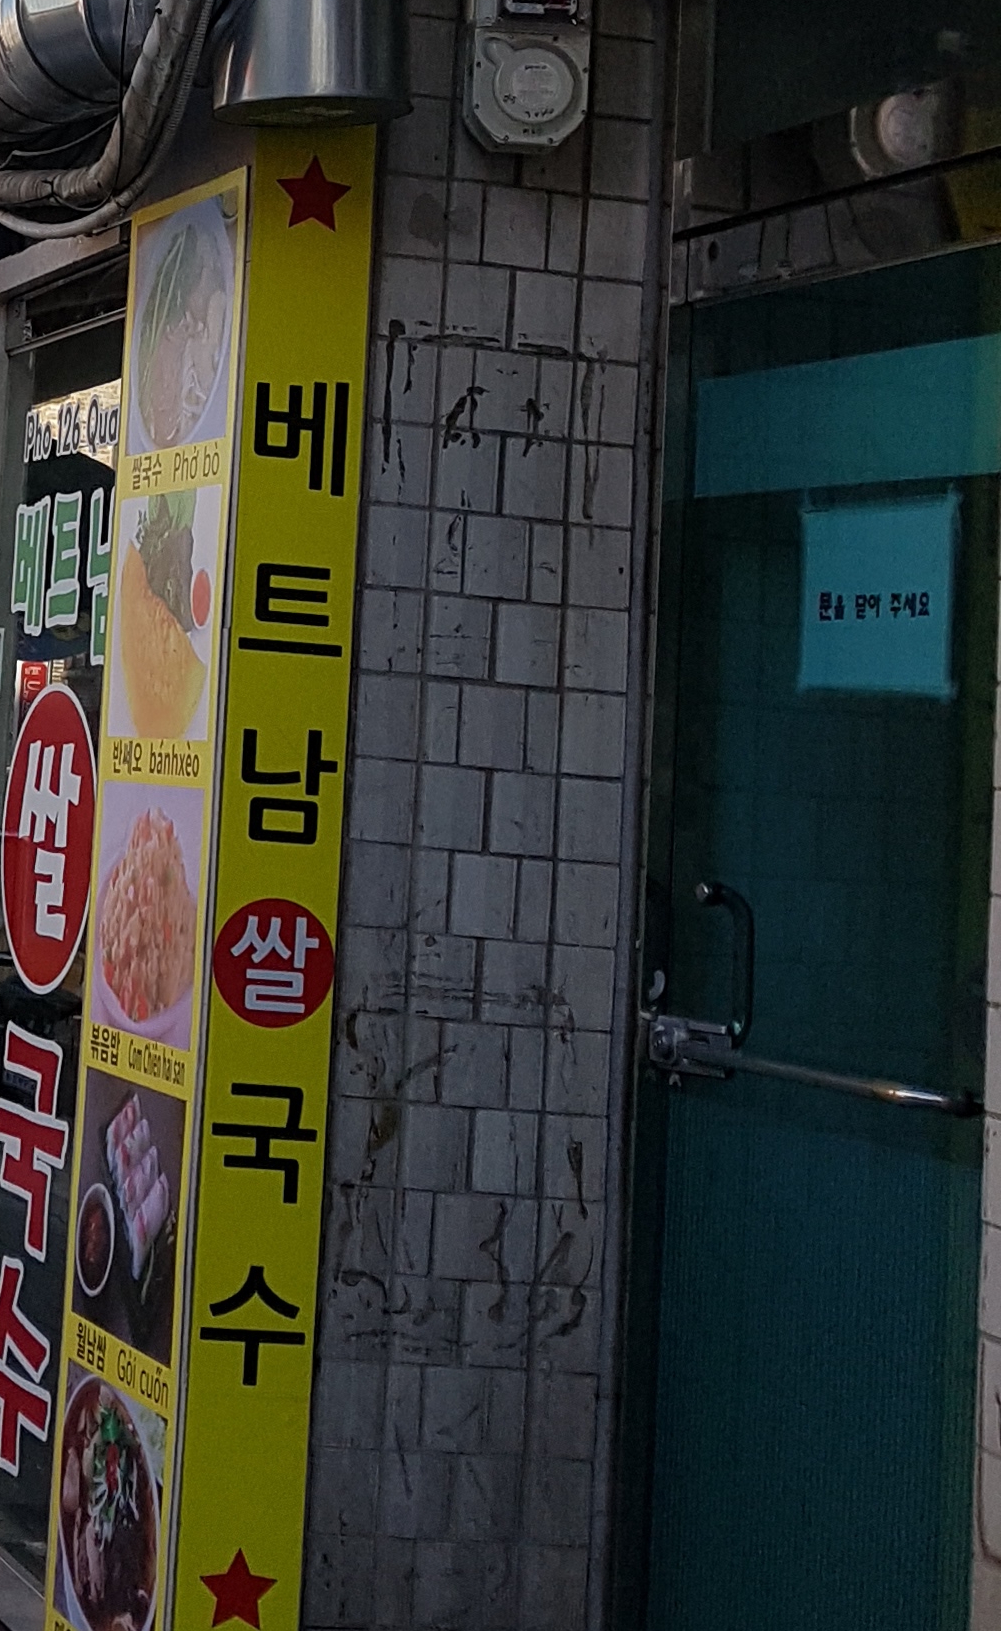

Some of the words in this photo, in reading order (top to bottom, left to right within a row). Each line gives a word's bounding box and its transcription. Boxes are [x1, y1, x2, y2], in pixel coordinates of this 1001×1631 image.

[23, 411, 50, 463] Pho
[55, 403, 80, 456] 126
[132, 453, 162, 490] 쌀국수
[238, 381, 350, 847] 베트남
[819, 591, 845, 621] 문을
[890, 591, 930, 619] 주세요
[91, 1023, 120, 1066] 볶음밥
[76, 1322, 106, 1373] 월남쌈
